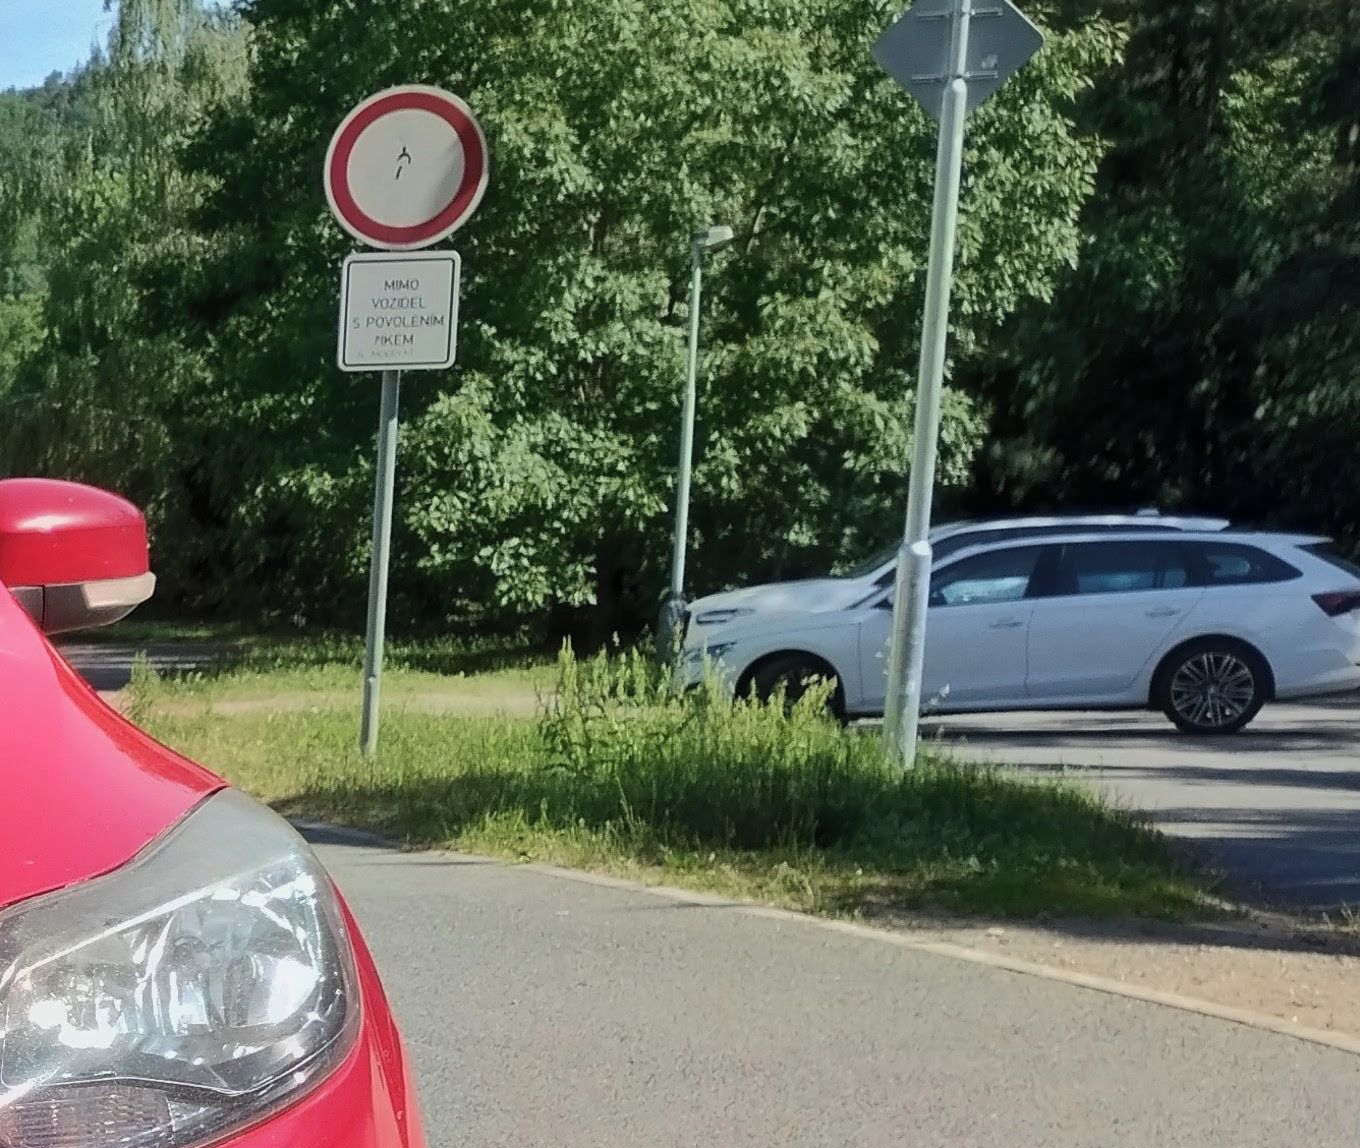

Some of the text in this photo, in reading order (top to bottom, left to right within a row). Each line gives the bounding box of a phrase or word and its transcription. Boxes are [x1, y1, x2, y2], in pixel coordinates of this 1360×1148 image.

[384, 279, 420, 291] MIMO
[372, 297, 426, 310] VOZIDEL
[352, 317, 361, 329] S
